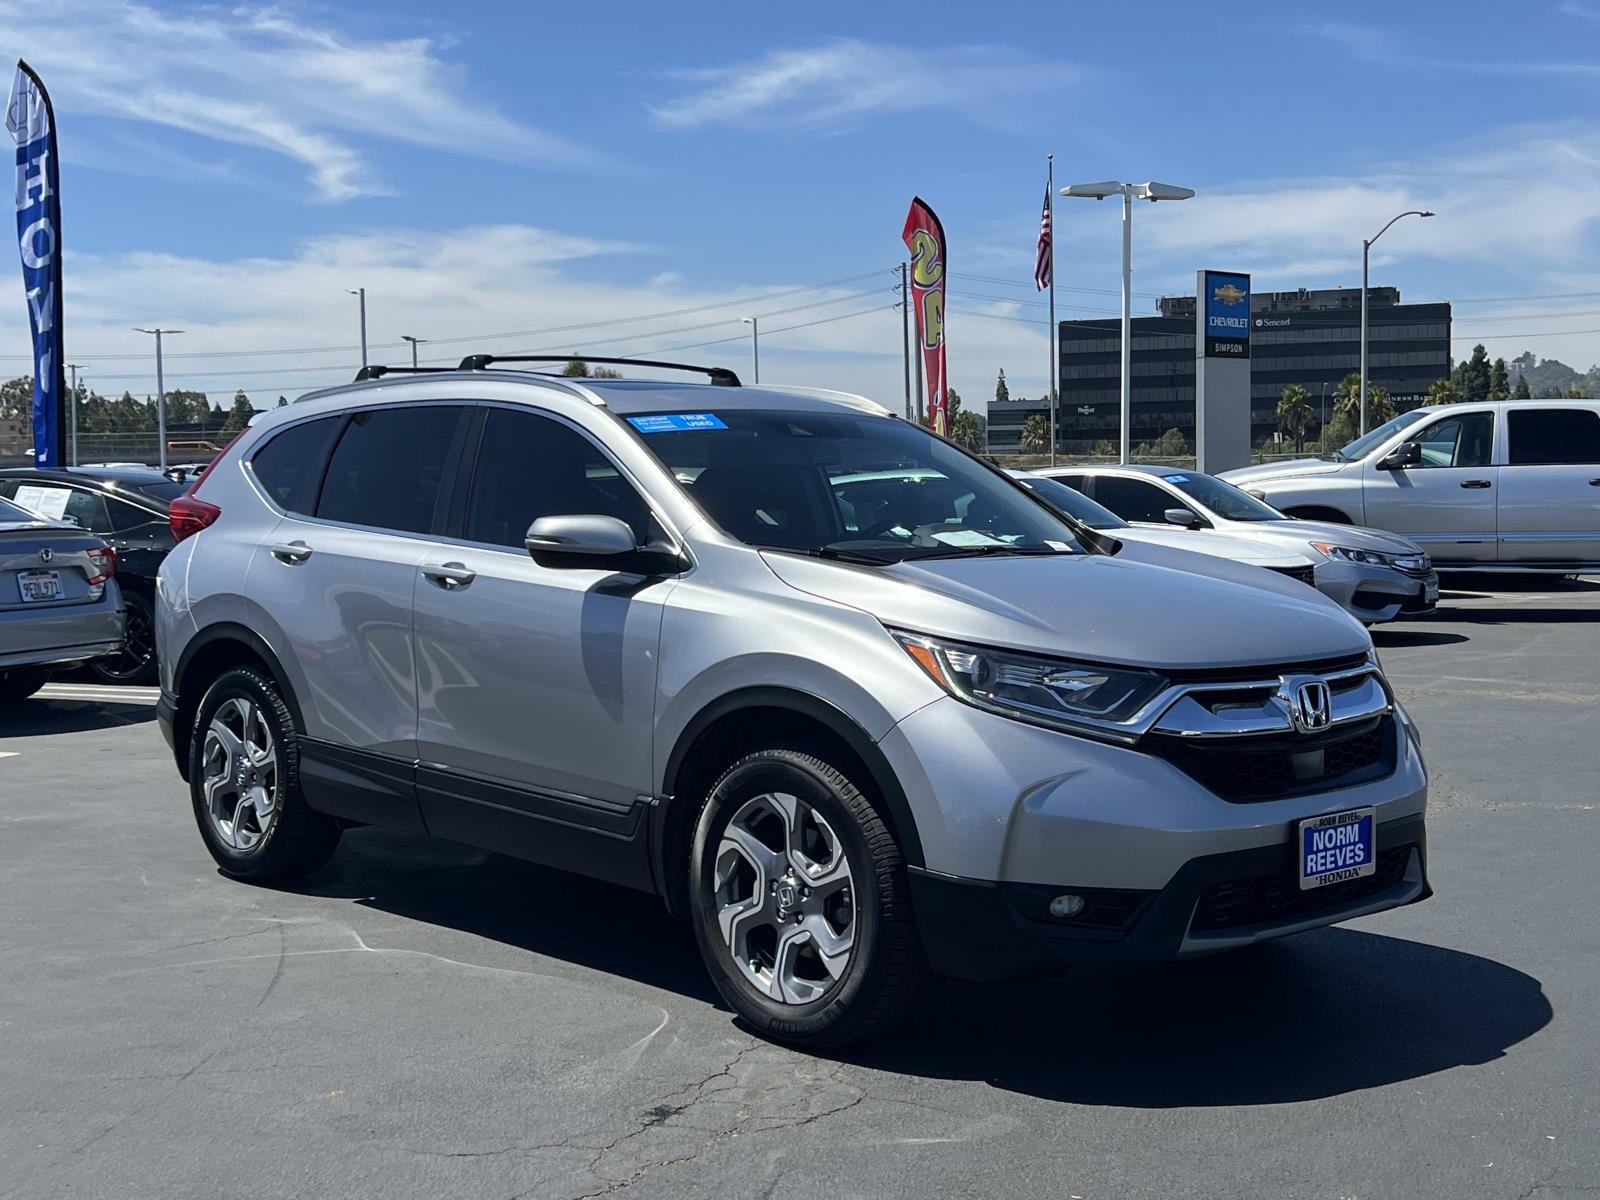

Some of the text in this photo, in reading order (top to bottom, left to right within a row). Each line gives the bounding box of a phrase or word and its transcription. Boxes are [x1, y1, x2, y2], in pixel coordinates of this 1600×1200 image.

[1209, 316, 1248, 328] CHEVROLET
[1215, 343, 1243, 353] SIMPSON
[1313, 823, 1359, 851] NORM
[1306, 843, 1364, 874] REEVES
